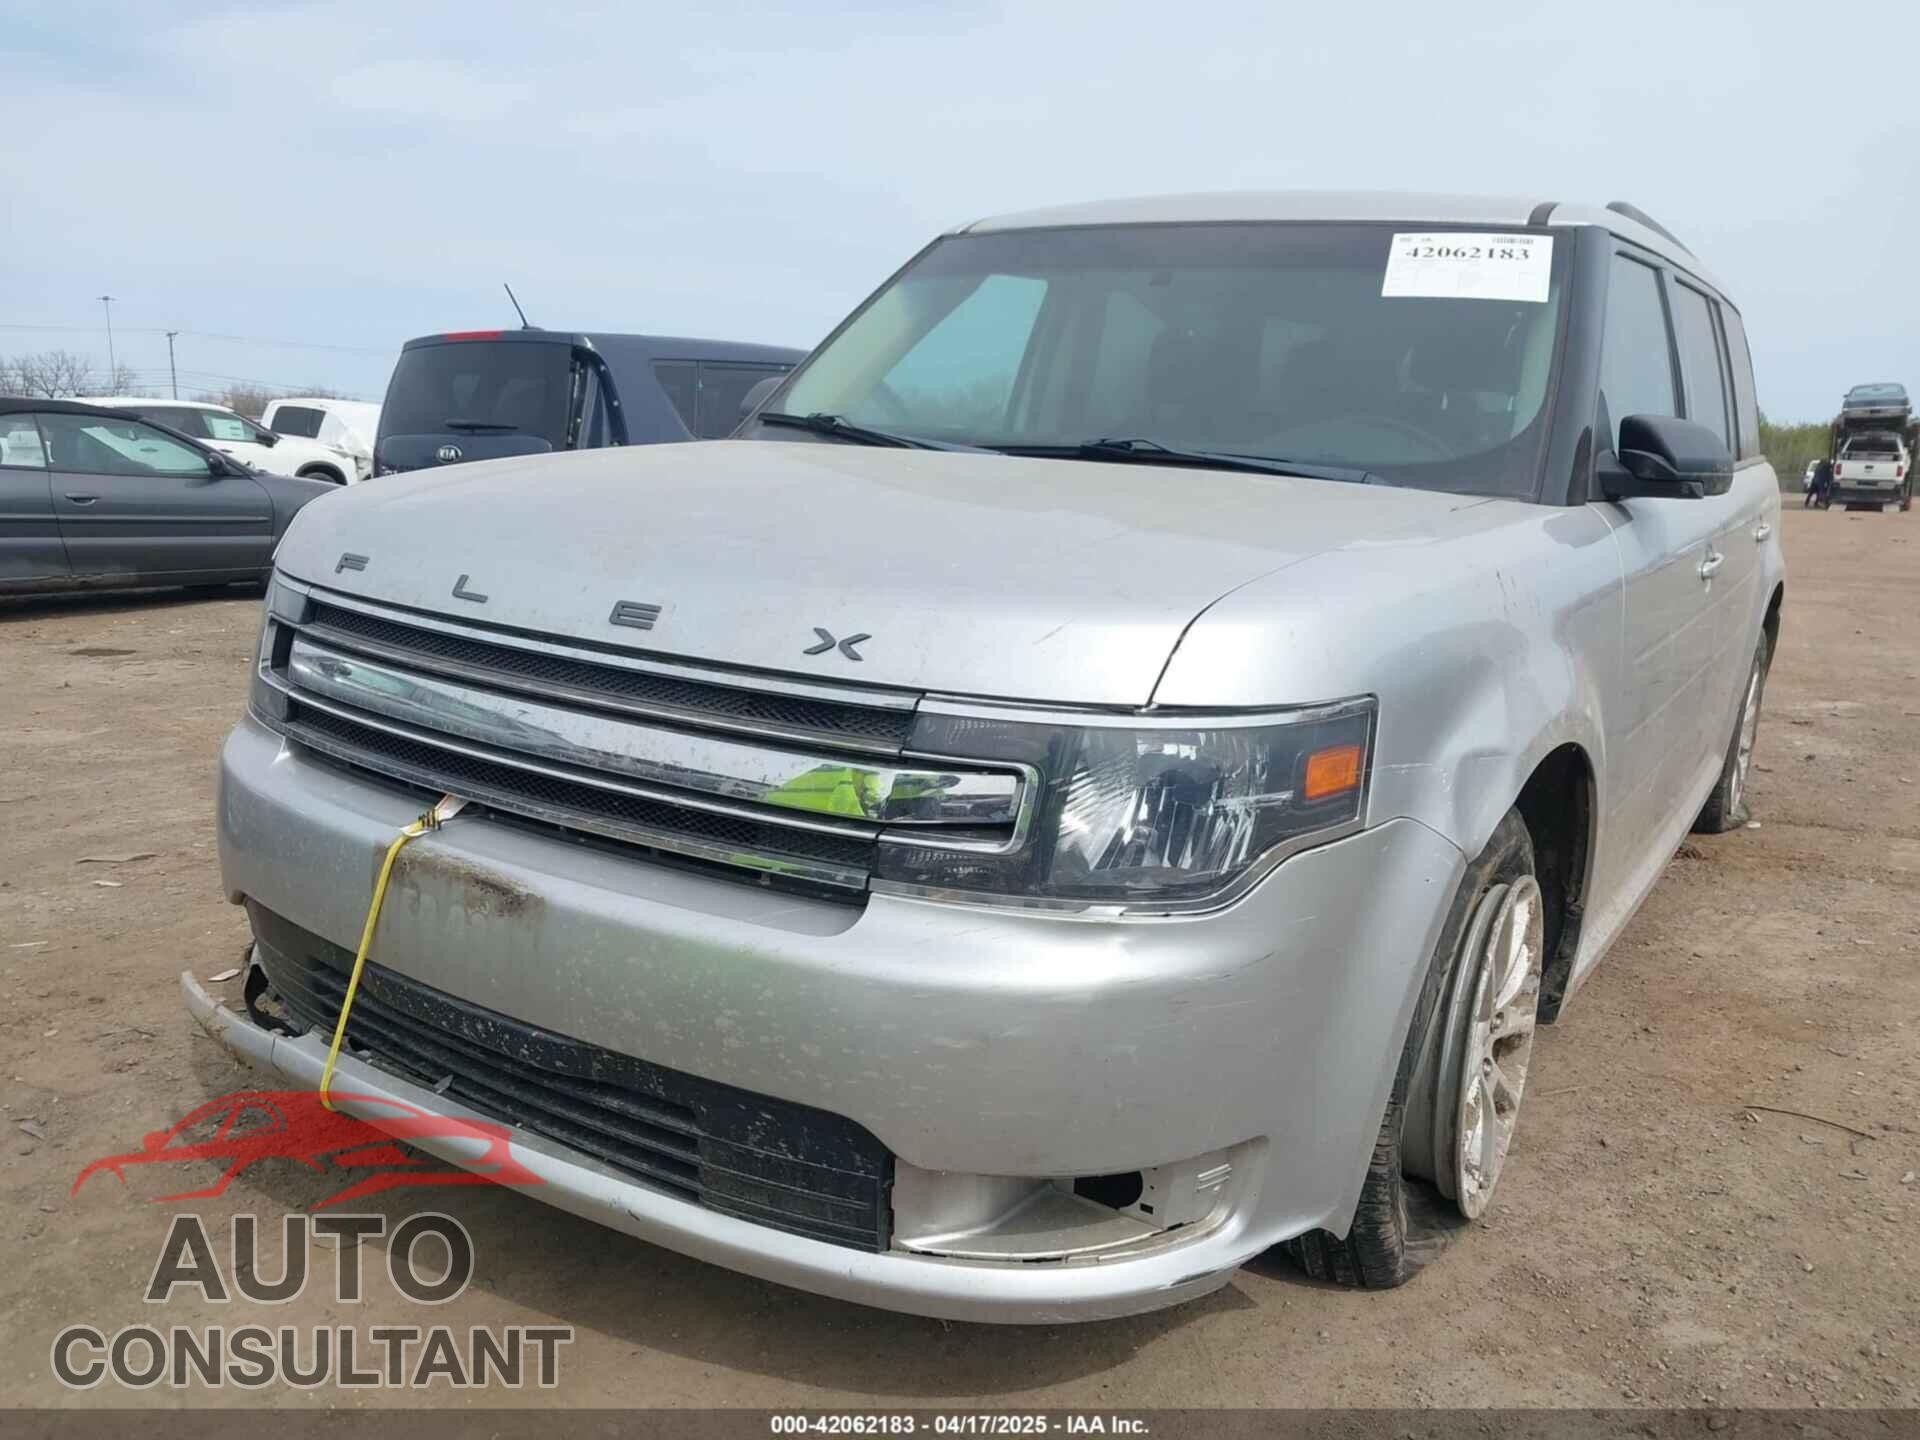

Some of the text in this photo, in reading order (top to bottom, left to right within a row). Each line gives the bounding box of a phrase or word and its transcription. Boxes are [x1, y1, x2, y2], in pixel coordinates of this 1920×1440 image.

[1405, 246, 1530, 260] 42062183
[438, 447, 458, 460] KIA
[336, 553, 872, 662] FLEX
